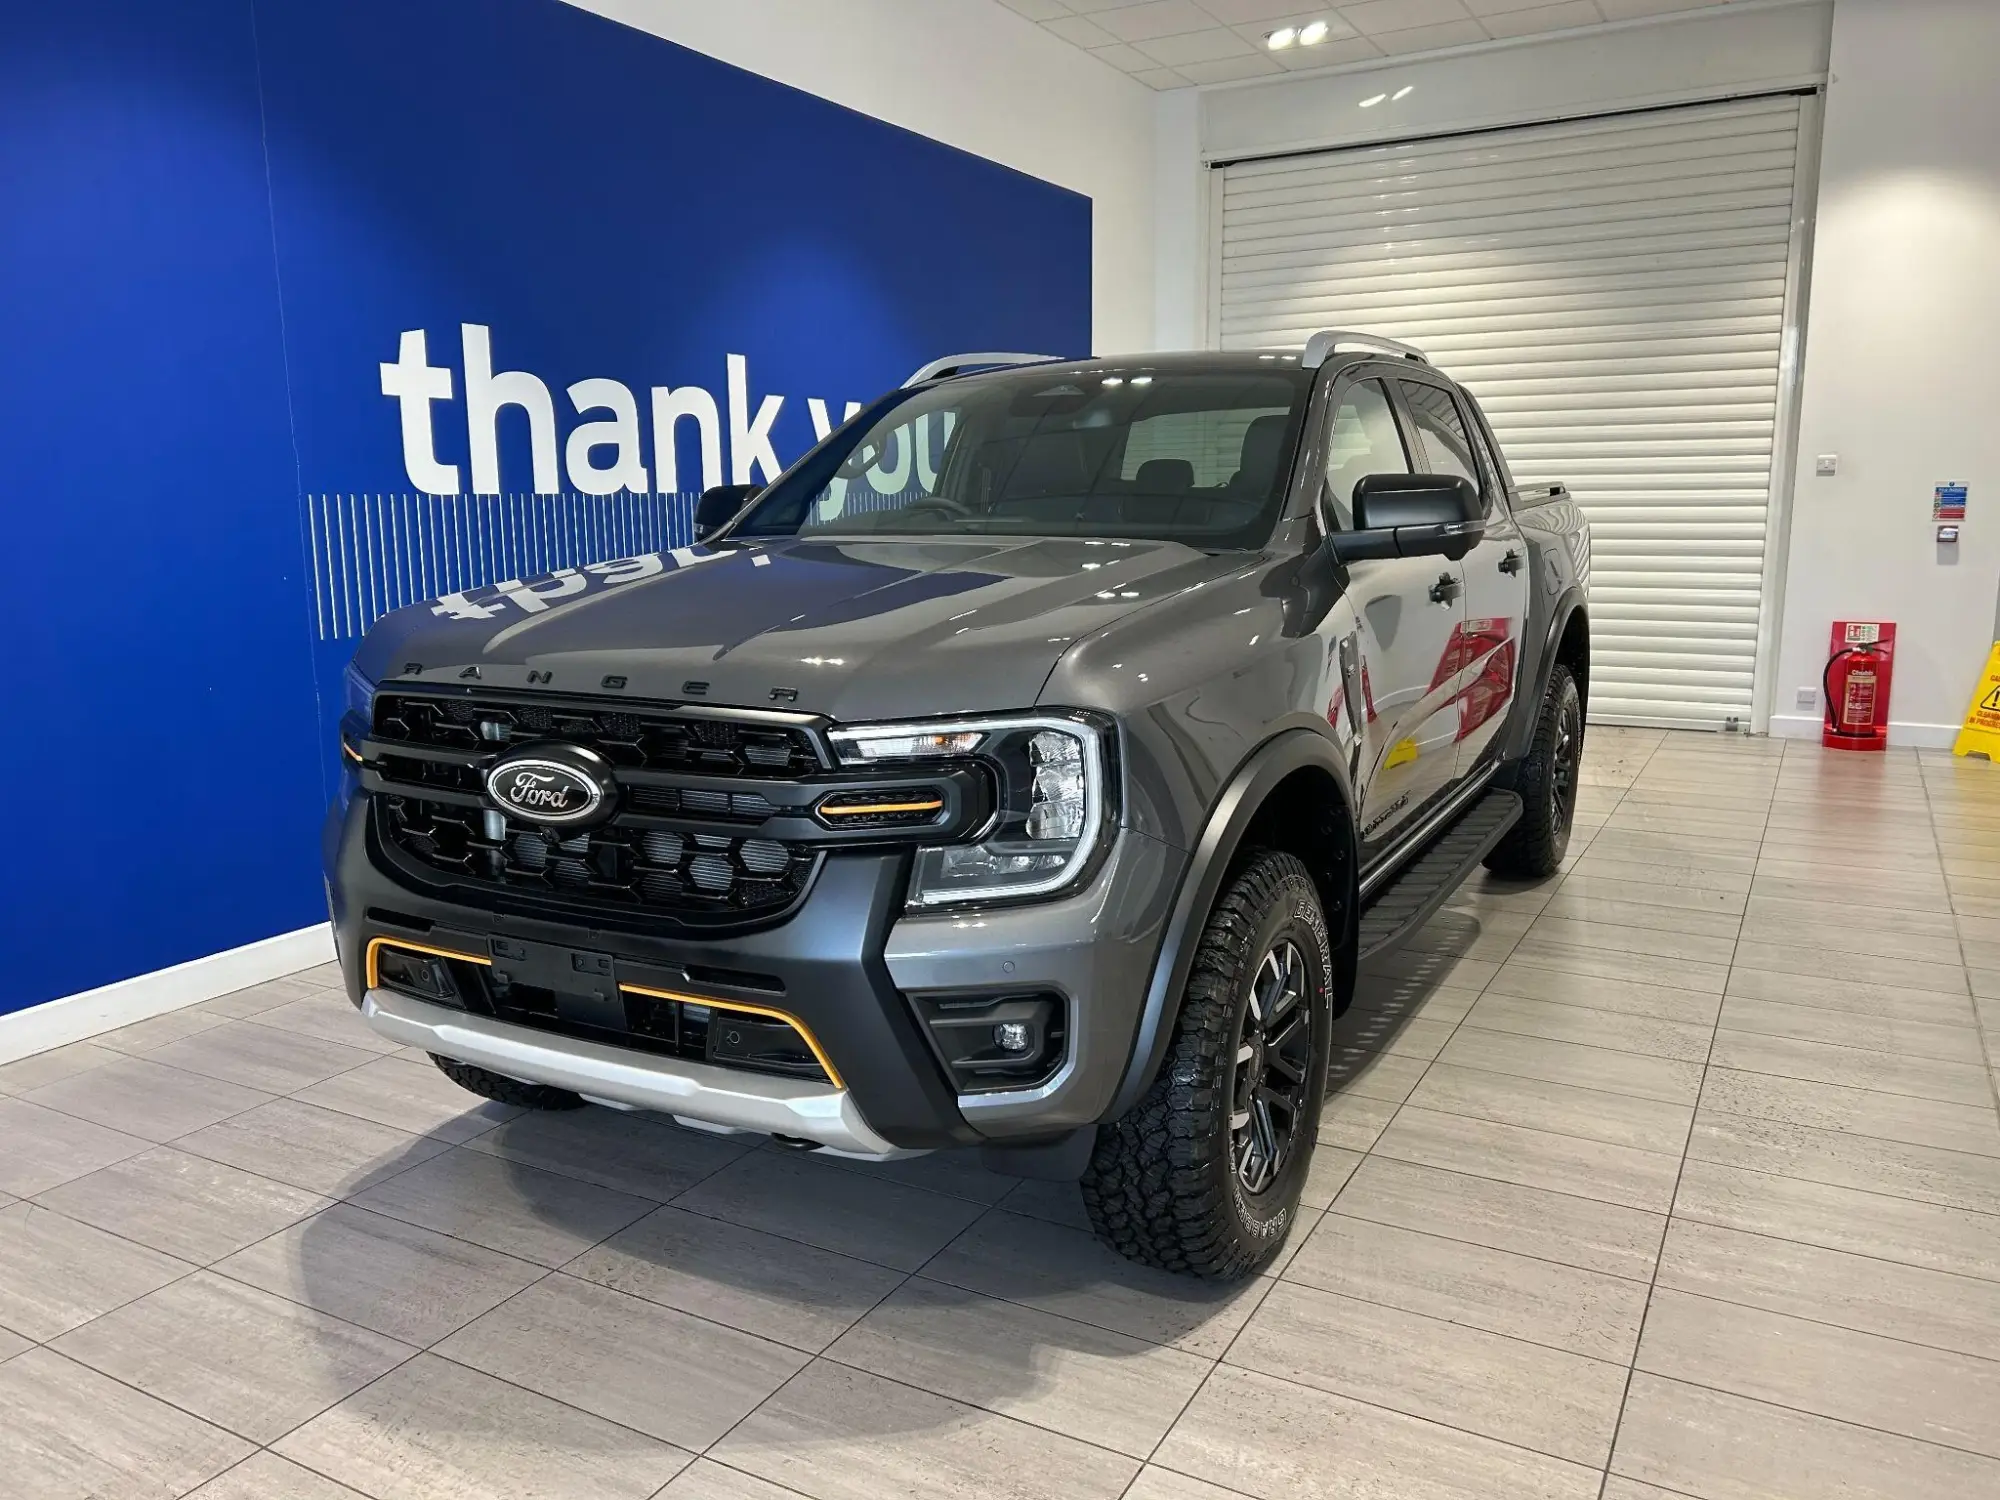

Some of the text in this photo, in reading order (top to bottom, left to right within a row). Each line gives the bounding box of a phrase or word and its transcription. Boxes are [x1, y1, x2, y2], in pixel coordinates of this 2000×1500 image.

[380, 323, 785, 495] thank
[403, 662, 799, 702] RANGER
[510, 772, 570, 809] Ford
[1294, 899, 1333, 1009] GENERAL
